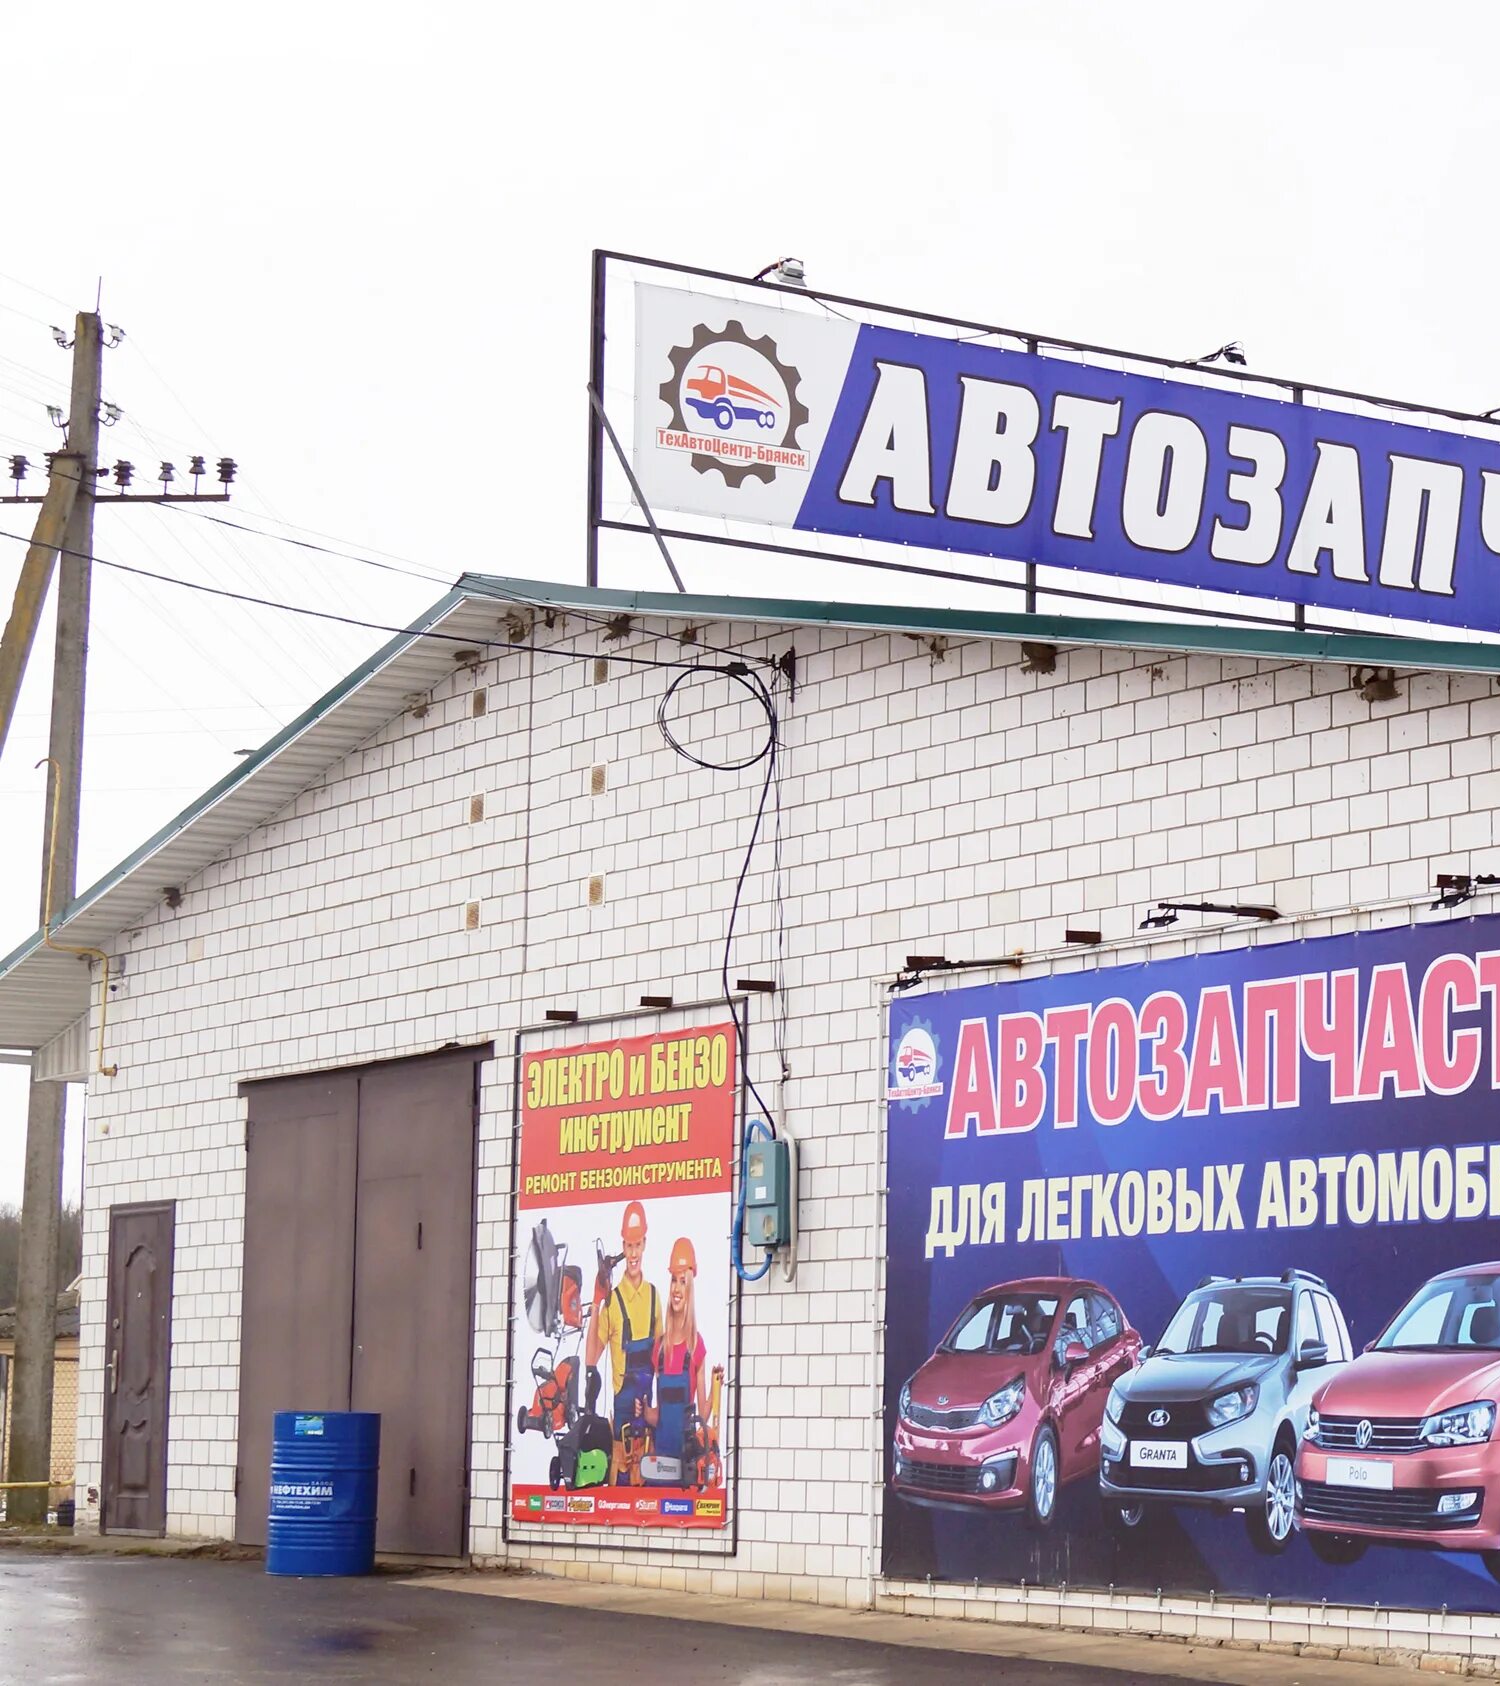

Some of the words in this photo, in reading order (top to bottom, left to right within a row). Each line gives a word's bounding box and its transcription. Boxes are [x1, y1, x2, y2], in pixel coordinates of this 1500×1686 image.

[658, 429, 806, 467] ТехАвтоЦентр-Брянск
[527, 1048, 625, 1110] ЭЛЕКТРО
[650, 1033, 728, 1095] БЕНЗО
[525, 1172, 577, 1196] РЕМОНТ
[579, 1157, 723, 1191] БЕНЗОИНСТРУМЕНТА
[925, 1183, 1006, 1260] ДЛЯ
[1017, 1163, 1246, 1243] ЛЕГКОВЫХ
[1139, 1446, 1178, 1461] GRANTA
[1348, 1466, 1368, 1481] Polo
